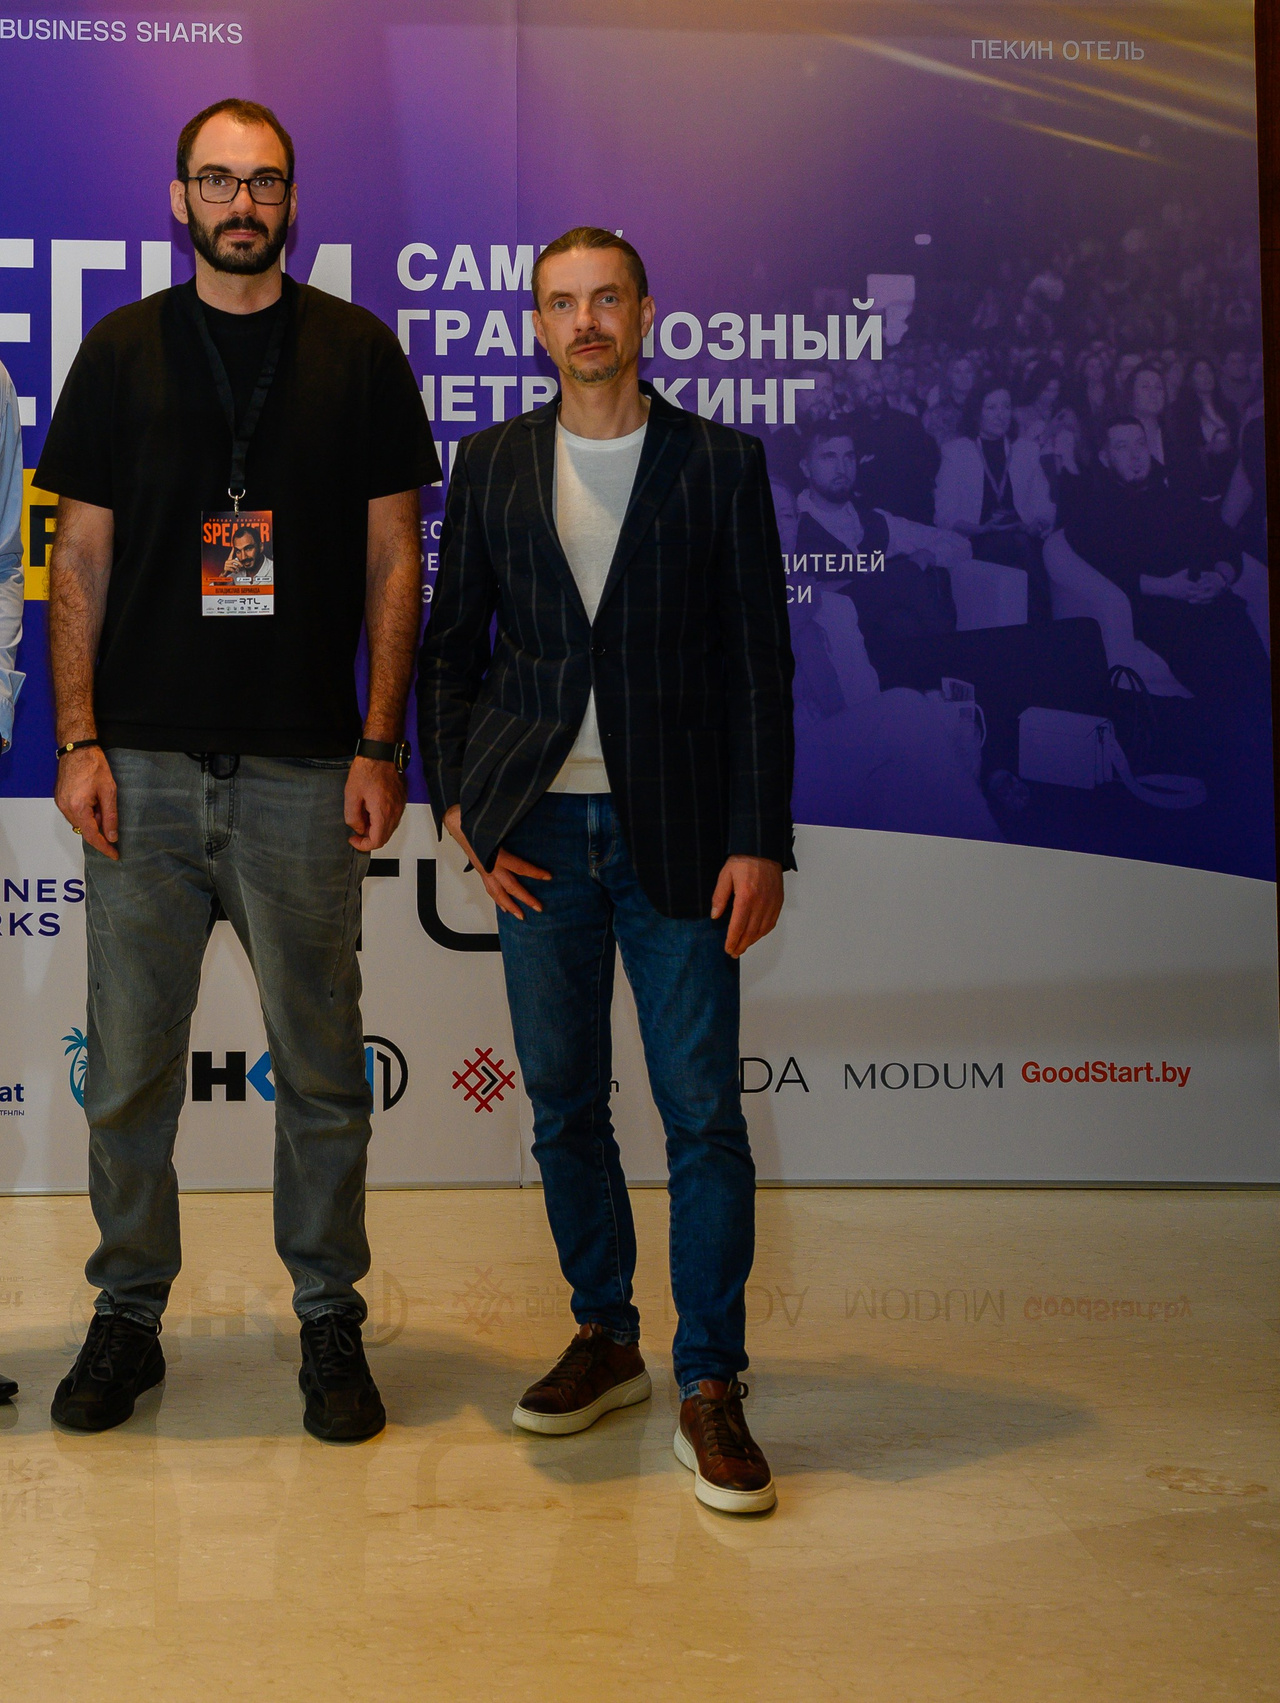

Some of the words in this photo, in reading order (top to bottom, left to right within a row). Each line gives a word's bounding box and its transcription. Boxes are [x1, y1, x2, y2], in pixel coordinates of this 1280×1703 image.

[0, 18, 127, 41] BUSINESS
[136, 21, 243, 44] SHARKS
[971, 39, 1053, 60] ПЕКИН
[1062, 40, 1145, 60] ОТЕЛЬ
[781, 550, 885, 575] ДИТЕЛЕЙ
[844, 1062, 1004, 1090] MODUM
[1021, 1060, 1192, 1088] GoodStart.by
